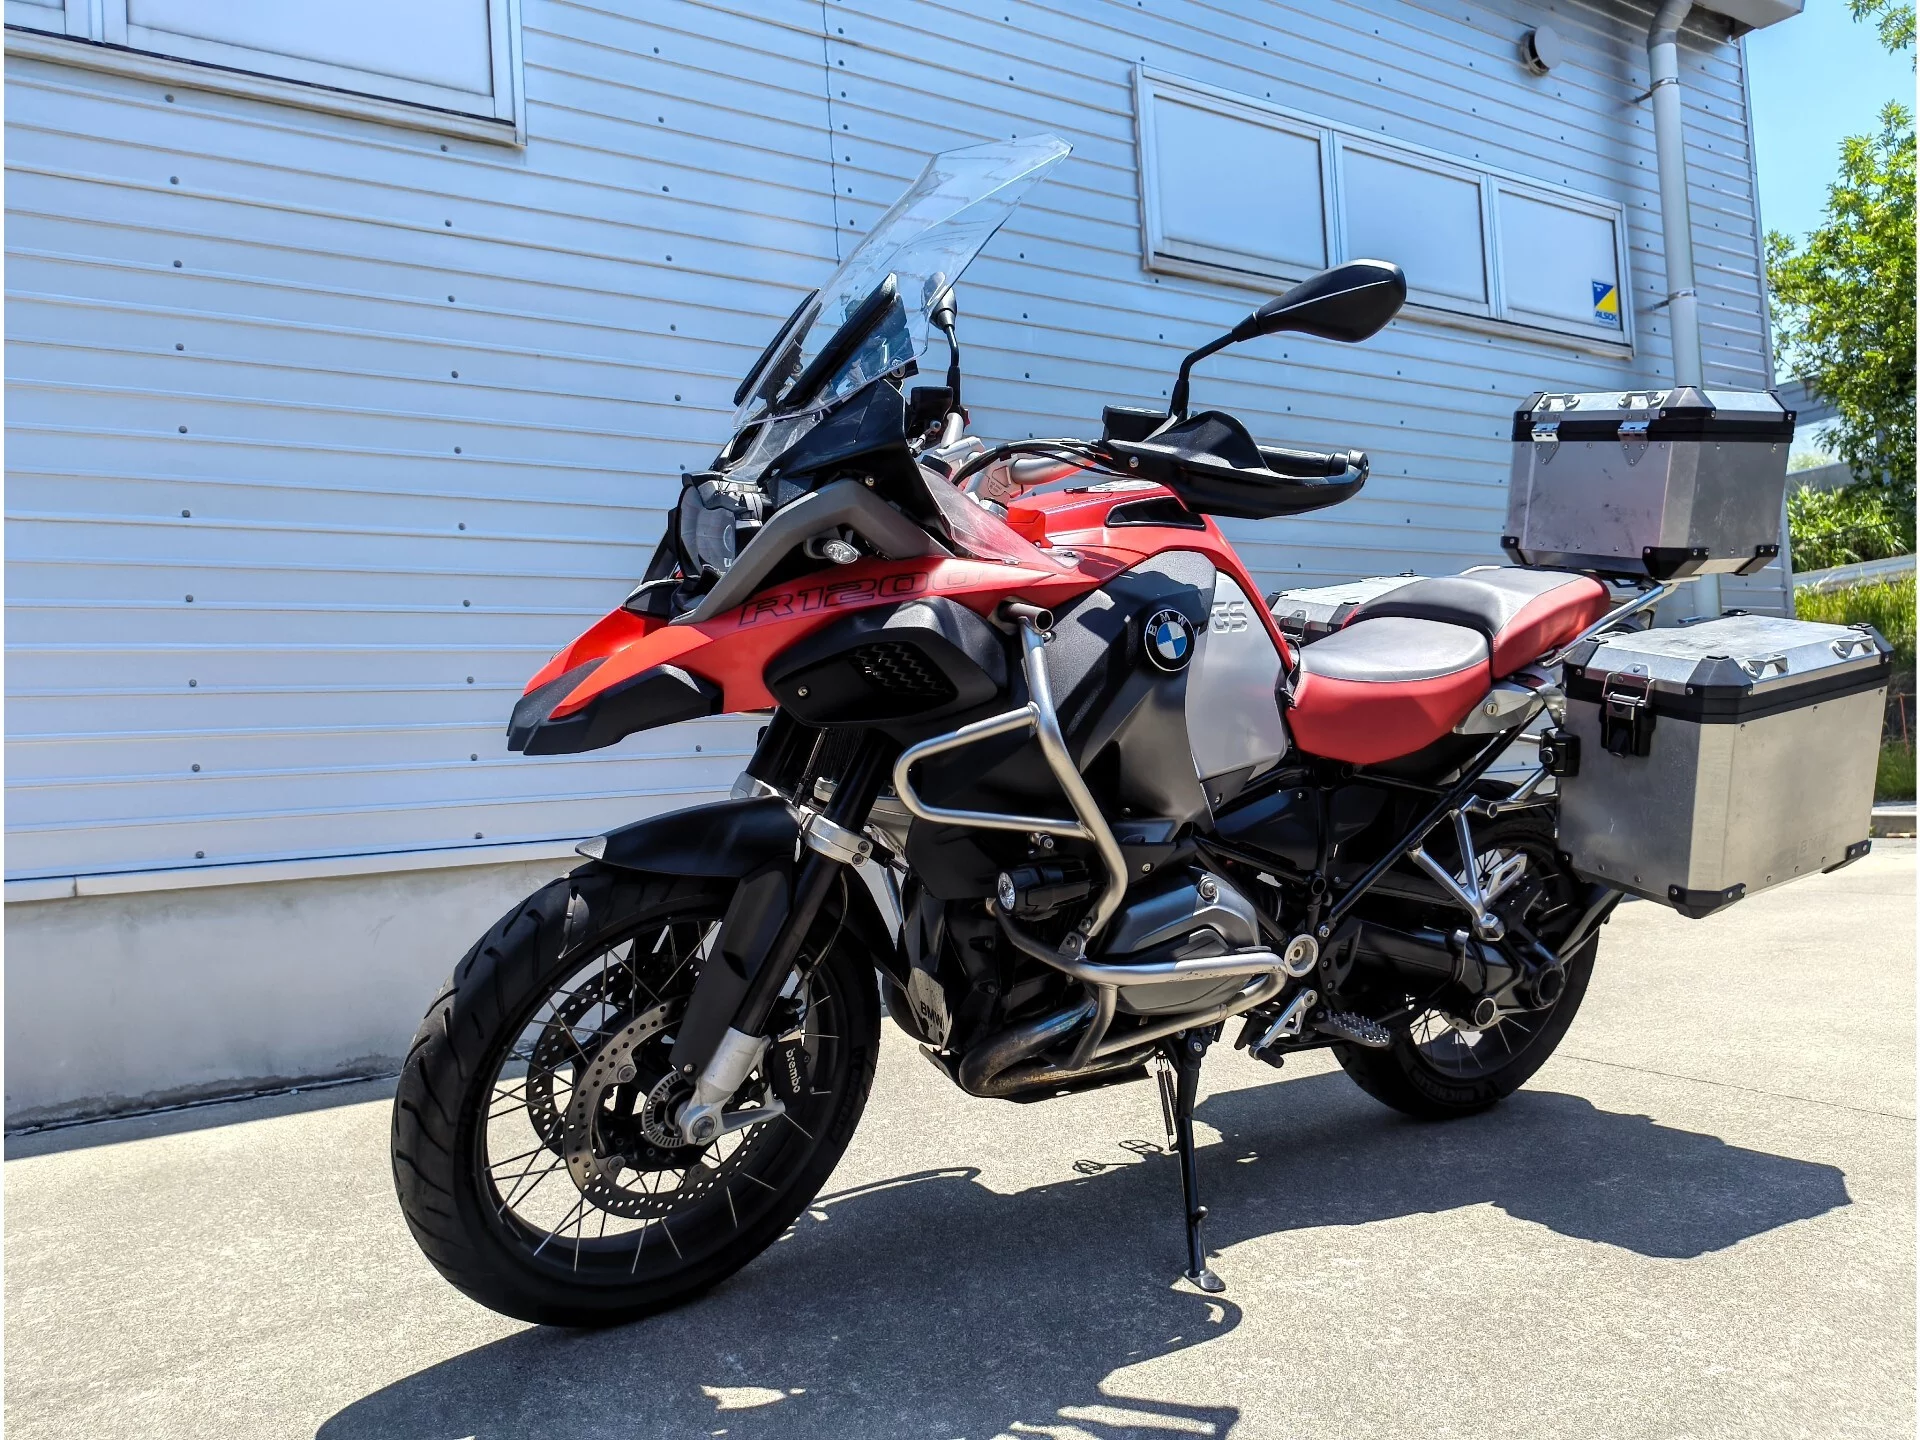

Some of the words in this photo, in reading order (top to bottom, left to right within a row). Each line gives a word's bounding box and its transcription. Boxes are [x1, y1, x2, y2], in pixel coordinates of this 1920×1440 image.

[739, 568, 984, 626] R1200
[1147, 610, 1187, 637] BMW
[1211, 600, 1248, 634] GS
[920, 1000, 946, 1032] BMW
[785, 1047, 802, 1094] brembo
